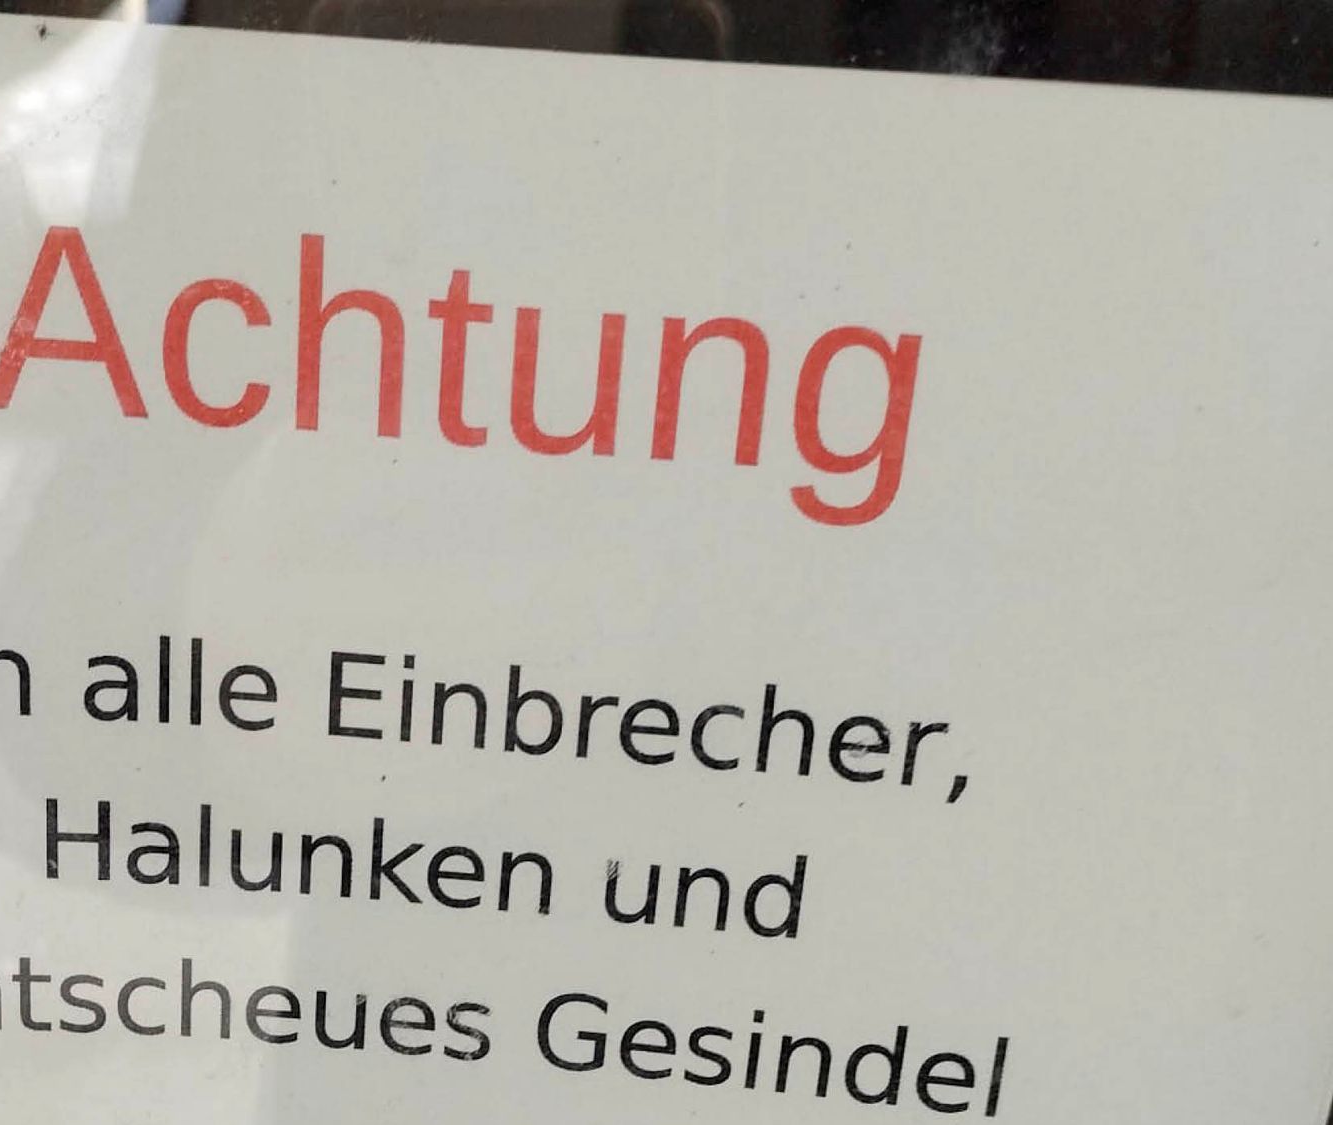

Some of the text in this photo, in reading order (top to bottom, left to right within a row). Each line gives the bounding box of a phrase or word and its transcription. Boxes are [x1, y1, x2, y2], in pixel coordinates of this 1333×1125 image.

[81, 632, 279, 733] alle
[326, 649, 971, 804] Einbrecher,
[43, 796, 810, 941] Halunken und
[535, 990, 1012, 1120] Gesindel
